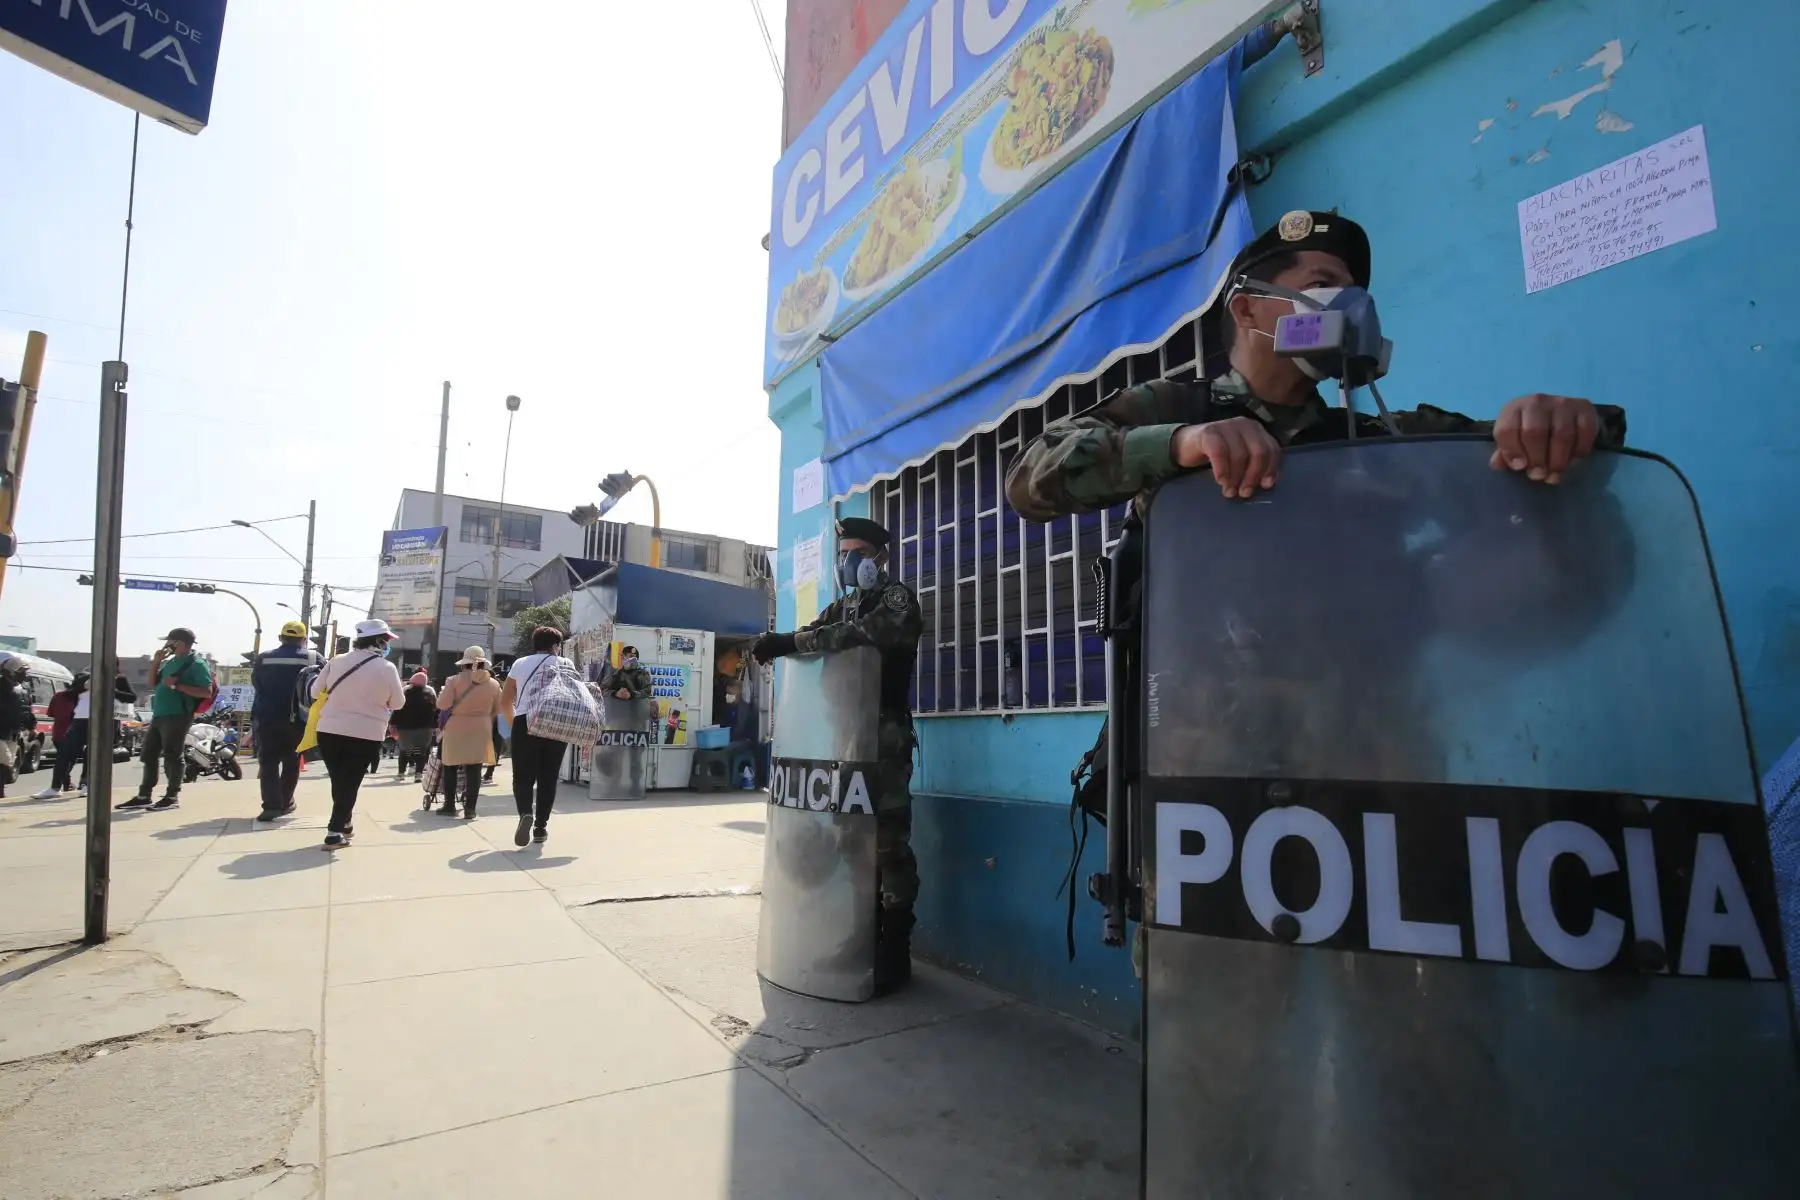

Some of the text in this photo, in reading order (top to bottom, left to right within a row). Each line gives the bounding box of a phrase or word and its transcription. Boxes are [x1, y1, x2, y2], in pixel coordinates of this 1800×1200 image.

[175, 20, 202, 44] DE
[650, 666, 683, 677] VENDE
[651, 677, 684, 687] EOSAS
[651, 687, 681, 697] ADAS
